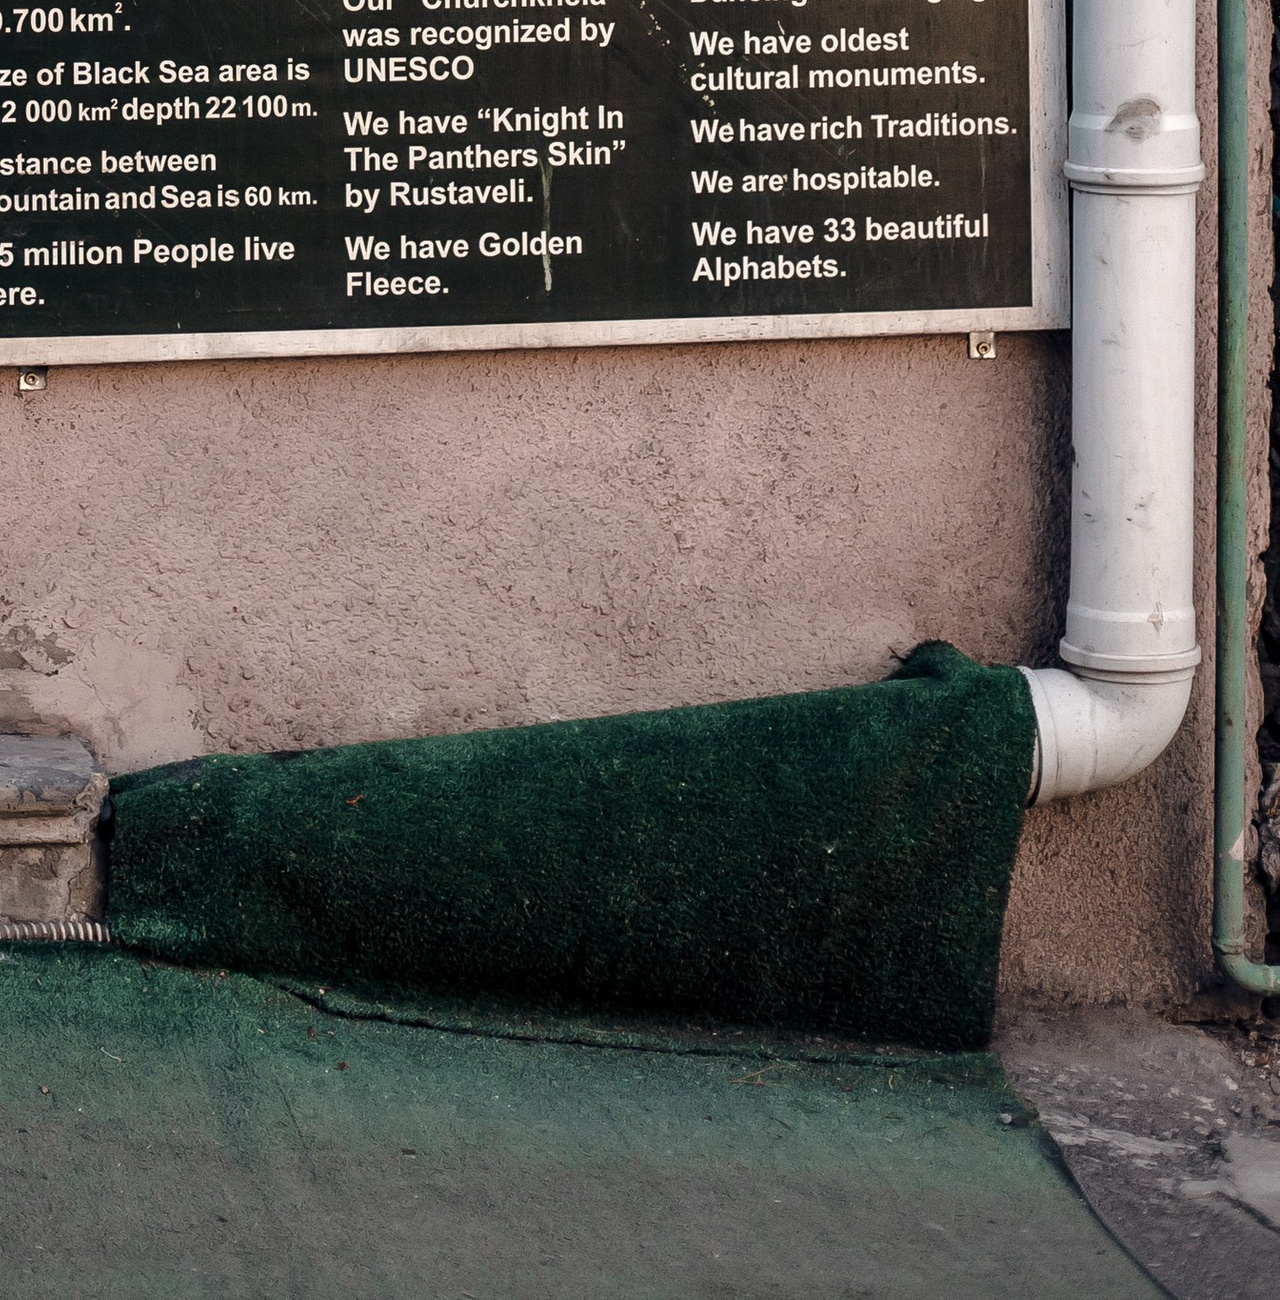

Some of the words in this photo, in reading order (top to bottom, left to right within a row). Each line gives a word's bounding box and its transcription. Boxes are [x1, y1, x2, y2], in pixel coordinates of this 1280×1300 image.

[342, 27, 401, 47] was
[410, 17, 571, 51] recognized
[580, 16, 616, 48] by
[689, 31, 735, 56] We
[744, 30, 812, 55] have
[820, 26, 910, 53] oldest
[36, 62, 66, 86] of
[73, 60, 151, 85] Black
[158, 59, 210, 84] Sea
[218, 63, 278, 83] area
[287, 57, 310, 81] is
[344, 55, 475, 83] UNESCO
[690, 62, 799, 92] cultural
[808, 60, 986, 89] monuments.
[25, 99, 72, 123] 000
[121, 96, 200, 126] depth
[342, 111, 389, 136] We
[399, 110, 468, 135] have
[598, 104, 624, 130] In
[690, 118, 735, 143] We
[739, 118, 806, 142] have
[810, 115, 863, 140] rich
[870, 112, 1017, 139] Traditions.
[101, 150, 217, 174] between
[343, 146, 399, 172] The
[408, 143, 539, 170] Panthers
[690, 170, 734, 194] We
[741, 174, 784, 193] are
[793, 164, 940, 195] hospitable.
[104, 185, 156, 210] and
[160, 184, 212, 209] Sea
[217, 184, 240, 208] is
[244, 185, 272, 207] 60
[278, 186, 318, 206] km.
[345, 183, 381, 214] by
[390, 178, 533, 206] Rustaveli.
[691, 221, 737, 247] We
[746, 220, 815, 245] have
[823, 217, 856, 243] 33
[865, 212, 989, 241] beautiful
[24, 240, 123, 266] million
[133, 237, 235, 269] People
[244, 236, 295, 261] live
[344, 235, 391, 261] We
[400, 234, 469, 260] have
[478, 230, 583, 259] Golden
[346, 271, 449, 297] Fleece.
[692, 254, 847, 287] Alphabets.
